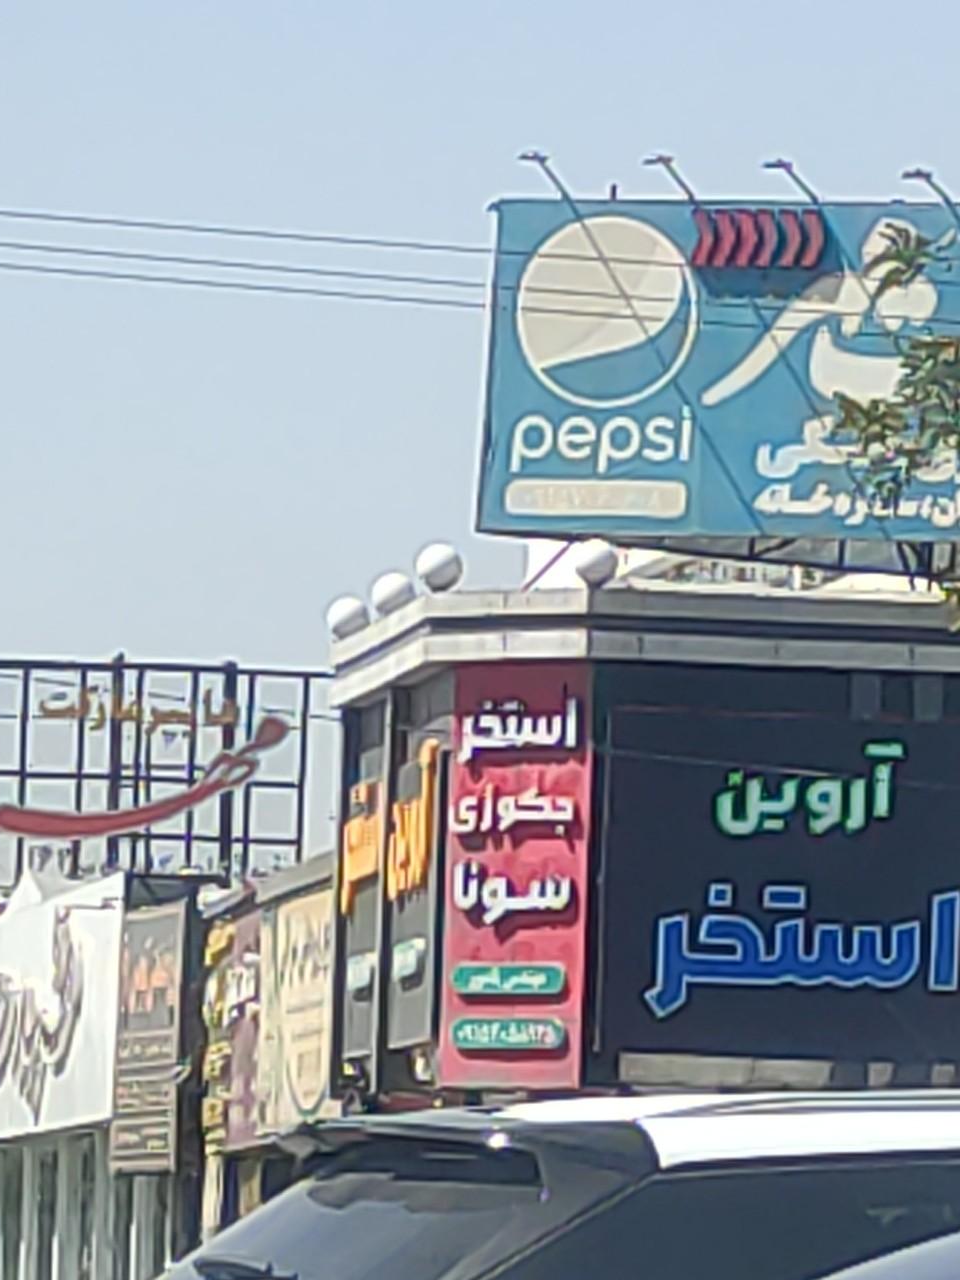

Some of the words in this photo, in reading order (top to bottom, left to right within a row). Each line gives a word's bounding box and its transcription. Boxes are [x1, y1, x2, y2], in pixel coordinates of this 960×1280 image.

[510, 405, 692, 474] pepsi
[457, 699, 577, 764] استخر
[449, 784, 575, 836] جکوزی
[715, 742, 905, 836] آروین
[452, 860, 572, 924] سونا
[644, 883, 960, 1018] استخر
